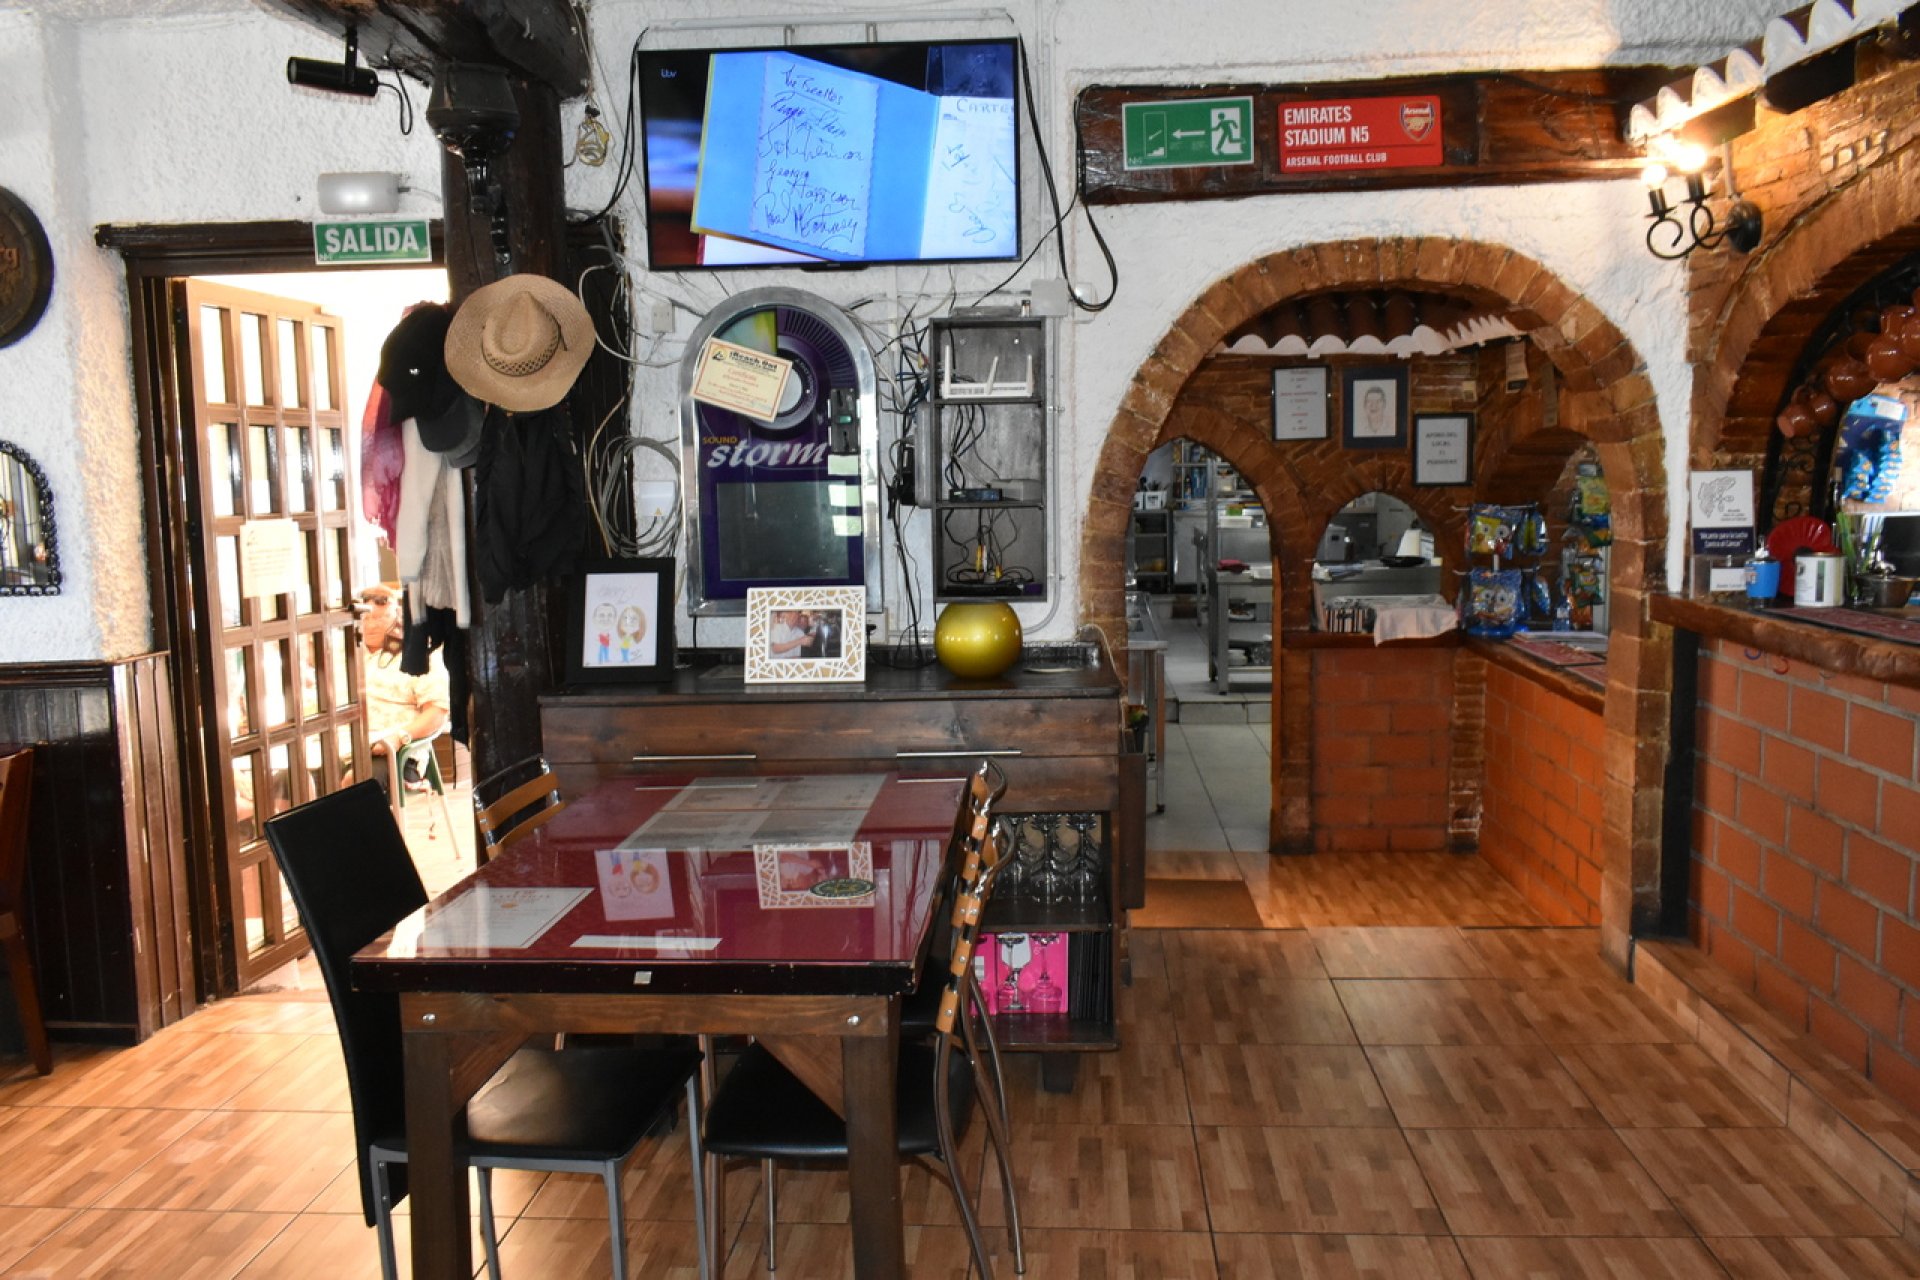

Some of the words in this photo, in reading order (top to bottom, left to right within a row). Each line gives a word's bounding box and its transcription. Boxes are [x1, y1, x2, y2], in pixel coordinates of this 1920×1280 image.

[1284, 105, 1352, 126] EMIRATES
[1285, 127, 1346, 147] STADIUM
[1350, 125, 1369, 144] N5
[1286, 156, 1322, 167] ARSENAL
[1323, 153, 1364, 165] FOOTBALL
[1365, 152, 1387, 163] CLUB
[324, 226, 419, 253] SALIDA
[703, 435, 738, 445] SOUND
[707, 439, 829, 468] storm
